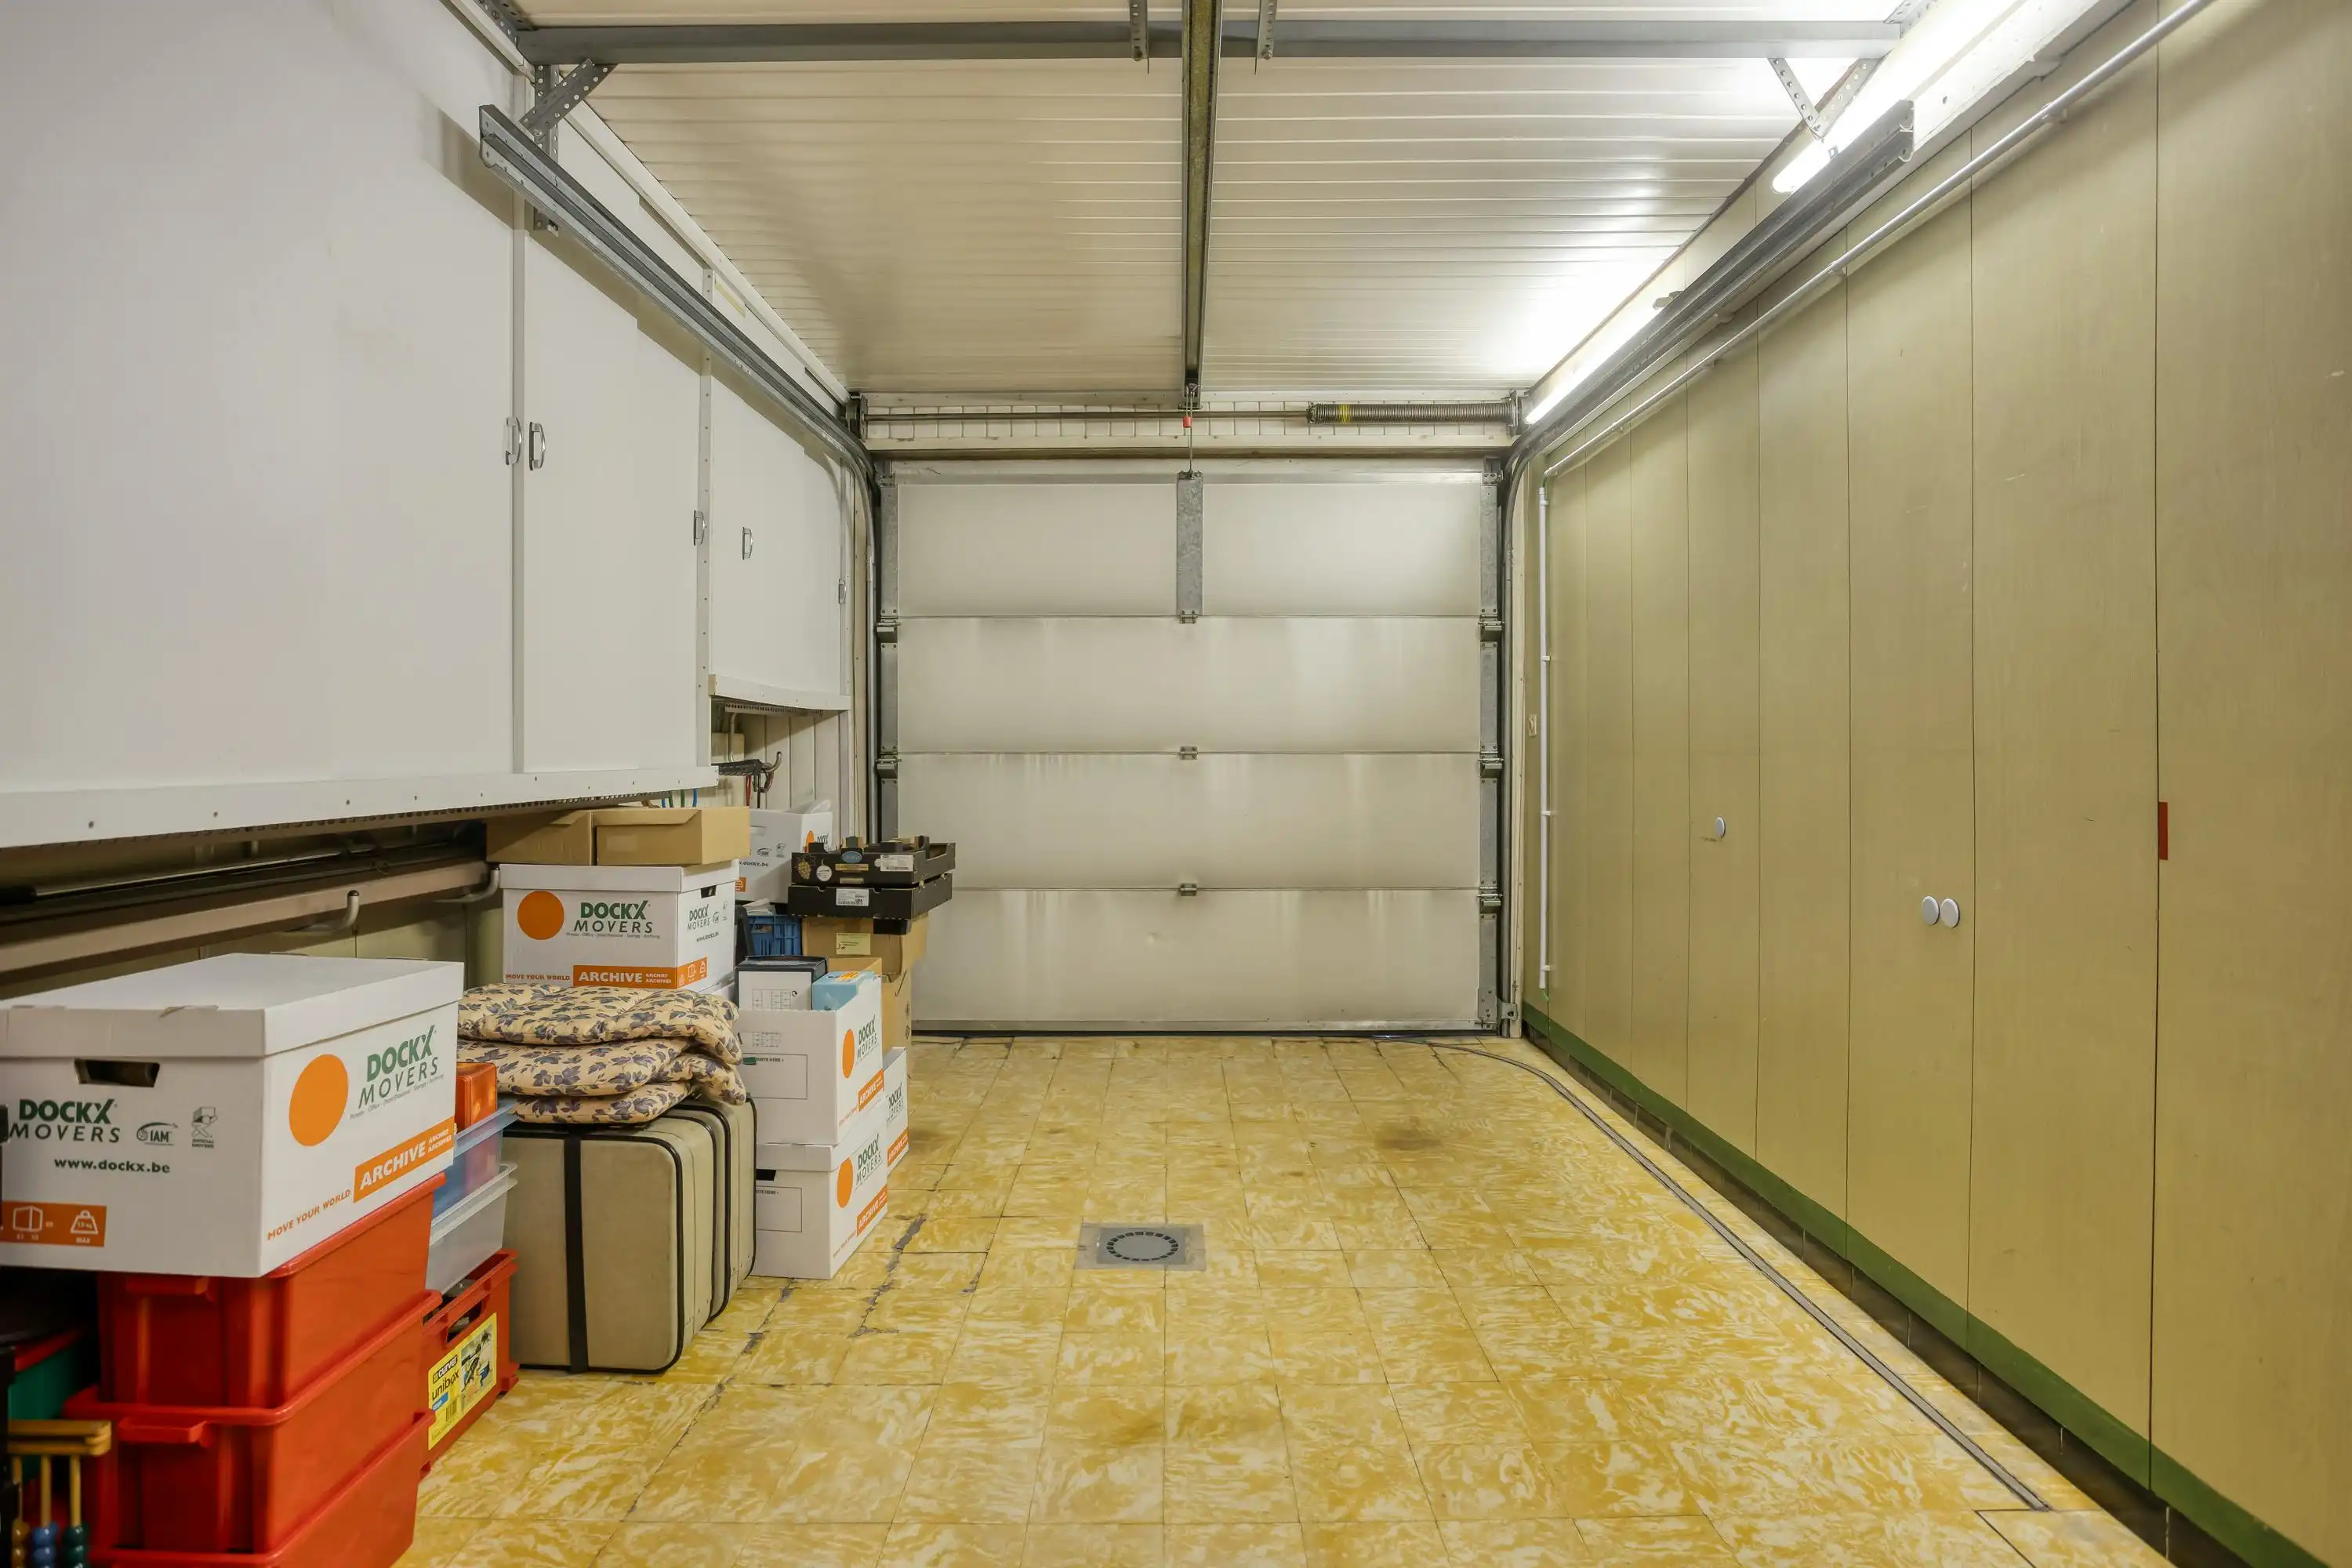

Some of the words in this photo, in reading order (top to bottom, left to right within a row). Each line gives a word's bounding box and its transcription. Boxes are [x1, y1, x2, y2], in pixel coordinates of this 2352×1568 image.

[580, 900, 648, 920] DOCKX
[689, 904, 709, 921] DOCKX
[573, 920, 653, 934] MOVERS
[688, 917, 710, 931] MOVERS
[579, 971, 642, 983] ARCHIVE
[858, 1014, 876, 1045] DOCKX
[367, 1025, 435, 1082] DOCKX
[857, 1033, 877, 1060] MOVERS
[358, 1057, 438, 1109] MOVERS
[19, 1098, 114, 1124] DOCKX
[9, 1122, 121, 1143] MOVERS
[150, 1130, 169, 1142] IAM
[858, 1133, 879, 1169] DOCKX
[54, 1158, 170, 1174] www.dockx.be
[360, 1142, 426, 1190] ARCHIVE
[856, 1152, 881, 1185] MOVERS
[267, 1219, 294, 1241] MOVE
[296, 1206, 320, 1225] YOUR
[322, 1189, 351, 1210] WORLD
[858, 1199, 879, 1230] ARCHIVE
[437, 1356, 458, 1377] curver
[432, 1370, 459, 1400] unibox
